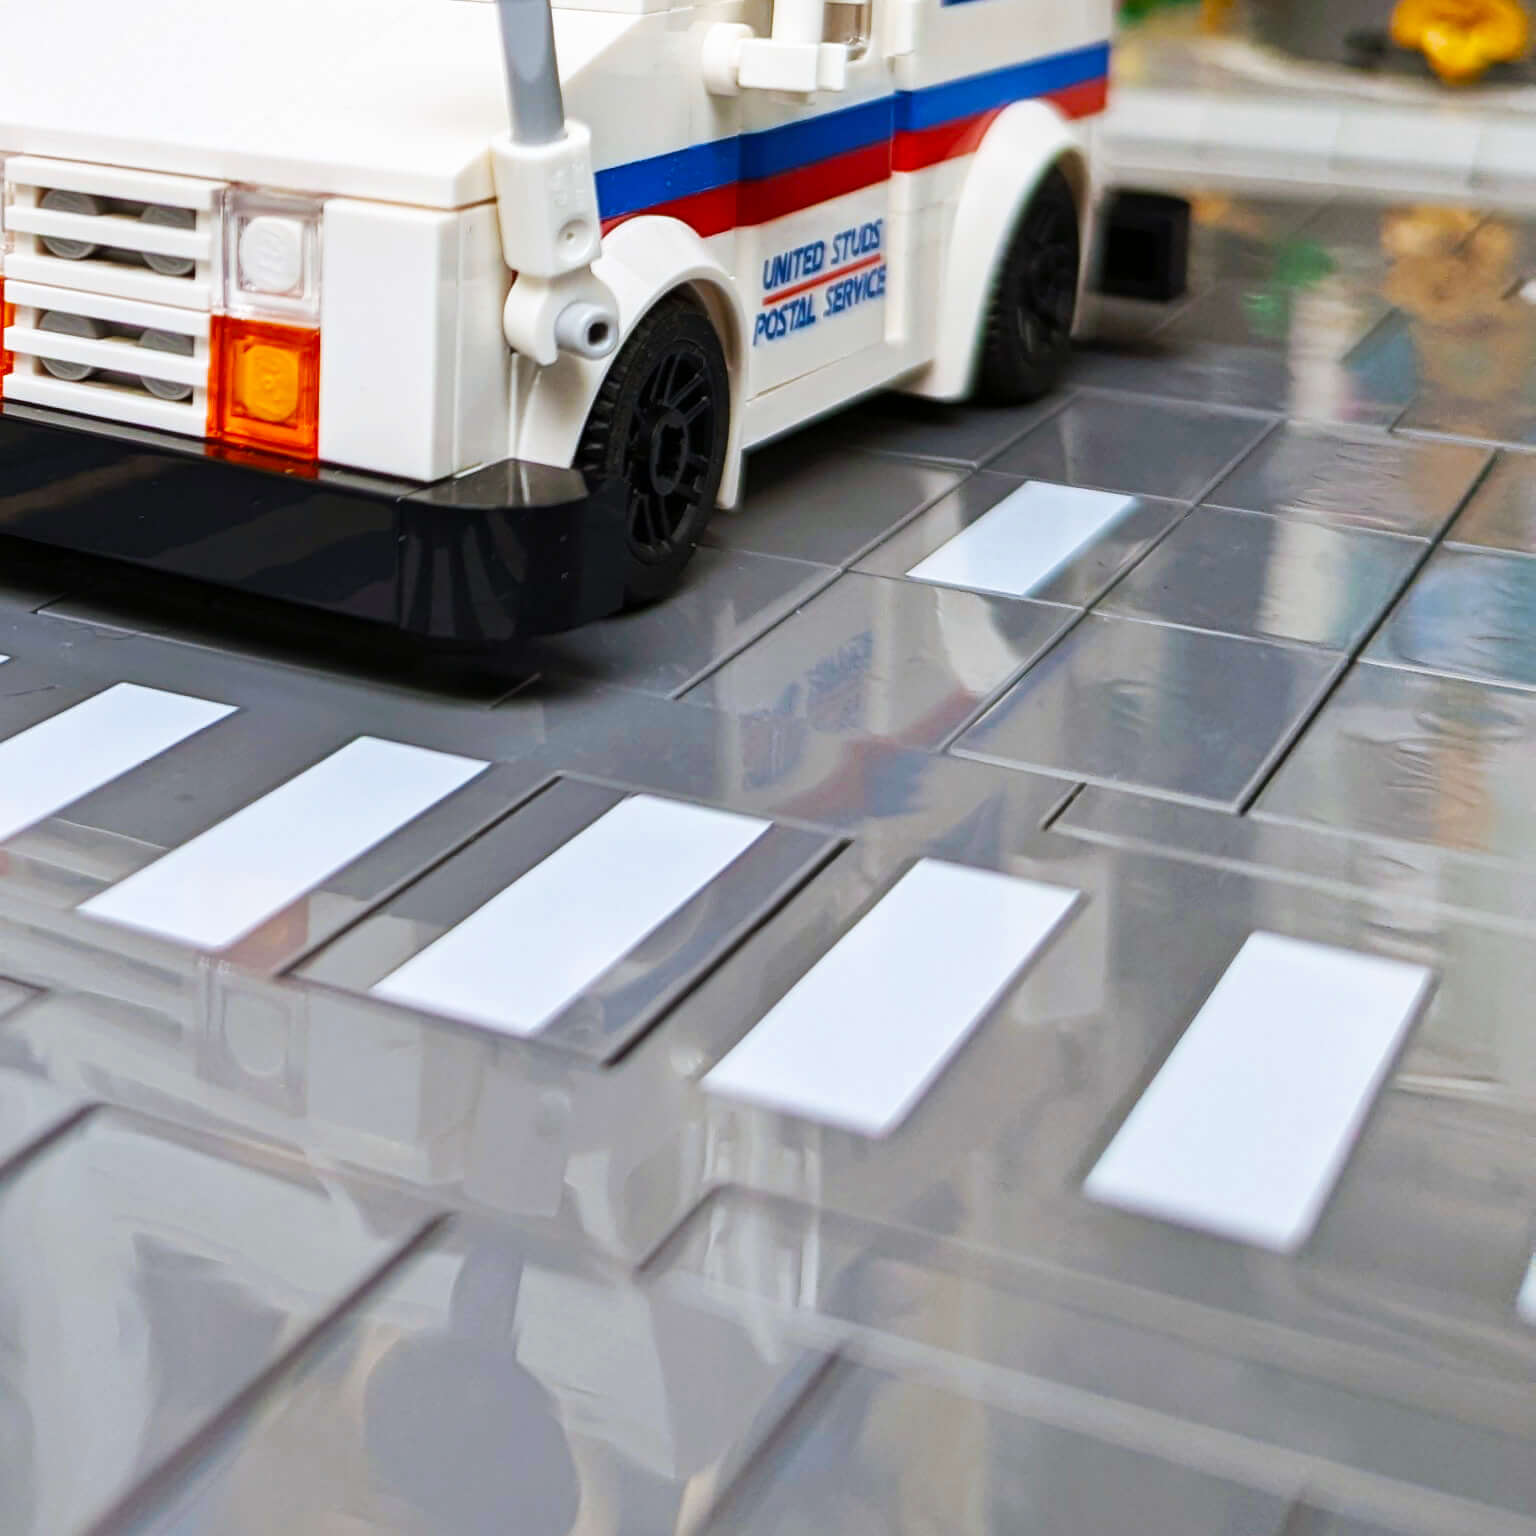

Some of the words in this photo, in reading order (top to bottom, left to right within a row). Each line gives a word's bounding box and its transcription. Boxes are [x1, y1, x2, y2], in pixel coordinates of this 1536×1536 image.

[762, 240, 825, 290] UNITED
[830, 217, 884, 265] STUDS
[753, 294, 817, 346] POSTAL
[823, 264, 888, 316] SERVICE
